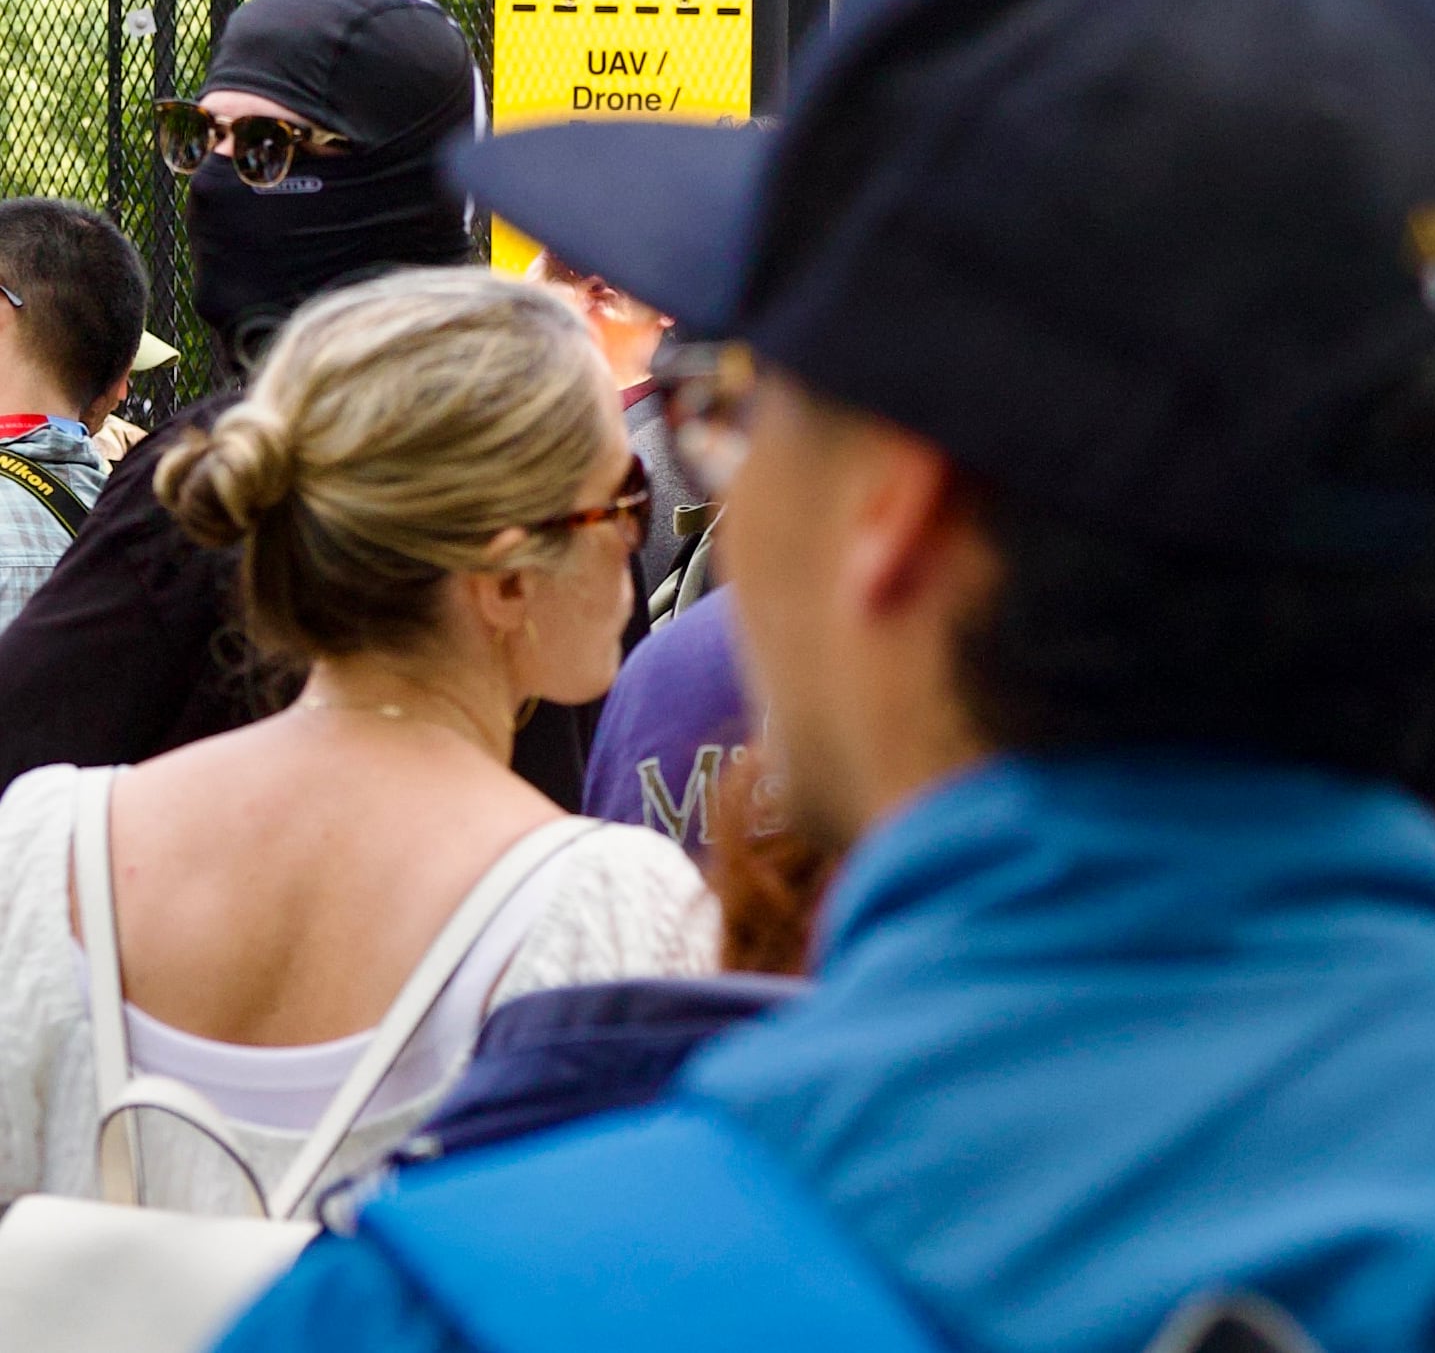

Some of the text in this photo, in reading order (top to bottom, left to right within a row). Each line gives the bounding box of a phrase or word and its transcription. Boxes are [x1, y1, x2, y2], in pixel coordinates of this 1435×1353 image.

[587, 51, 647, 75] UAV
[573, 86, 661, 111] Drone
[0, 454, 54, 496] Nikon
